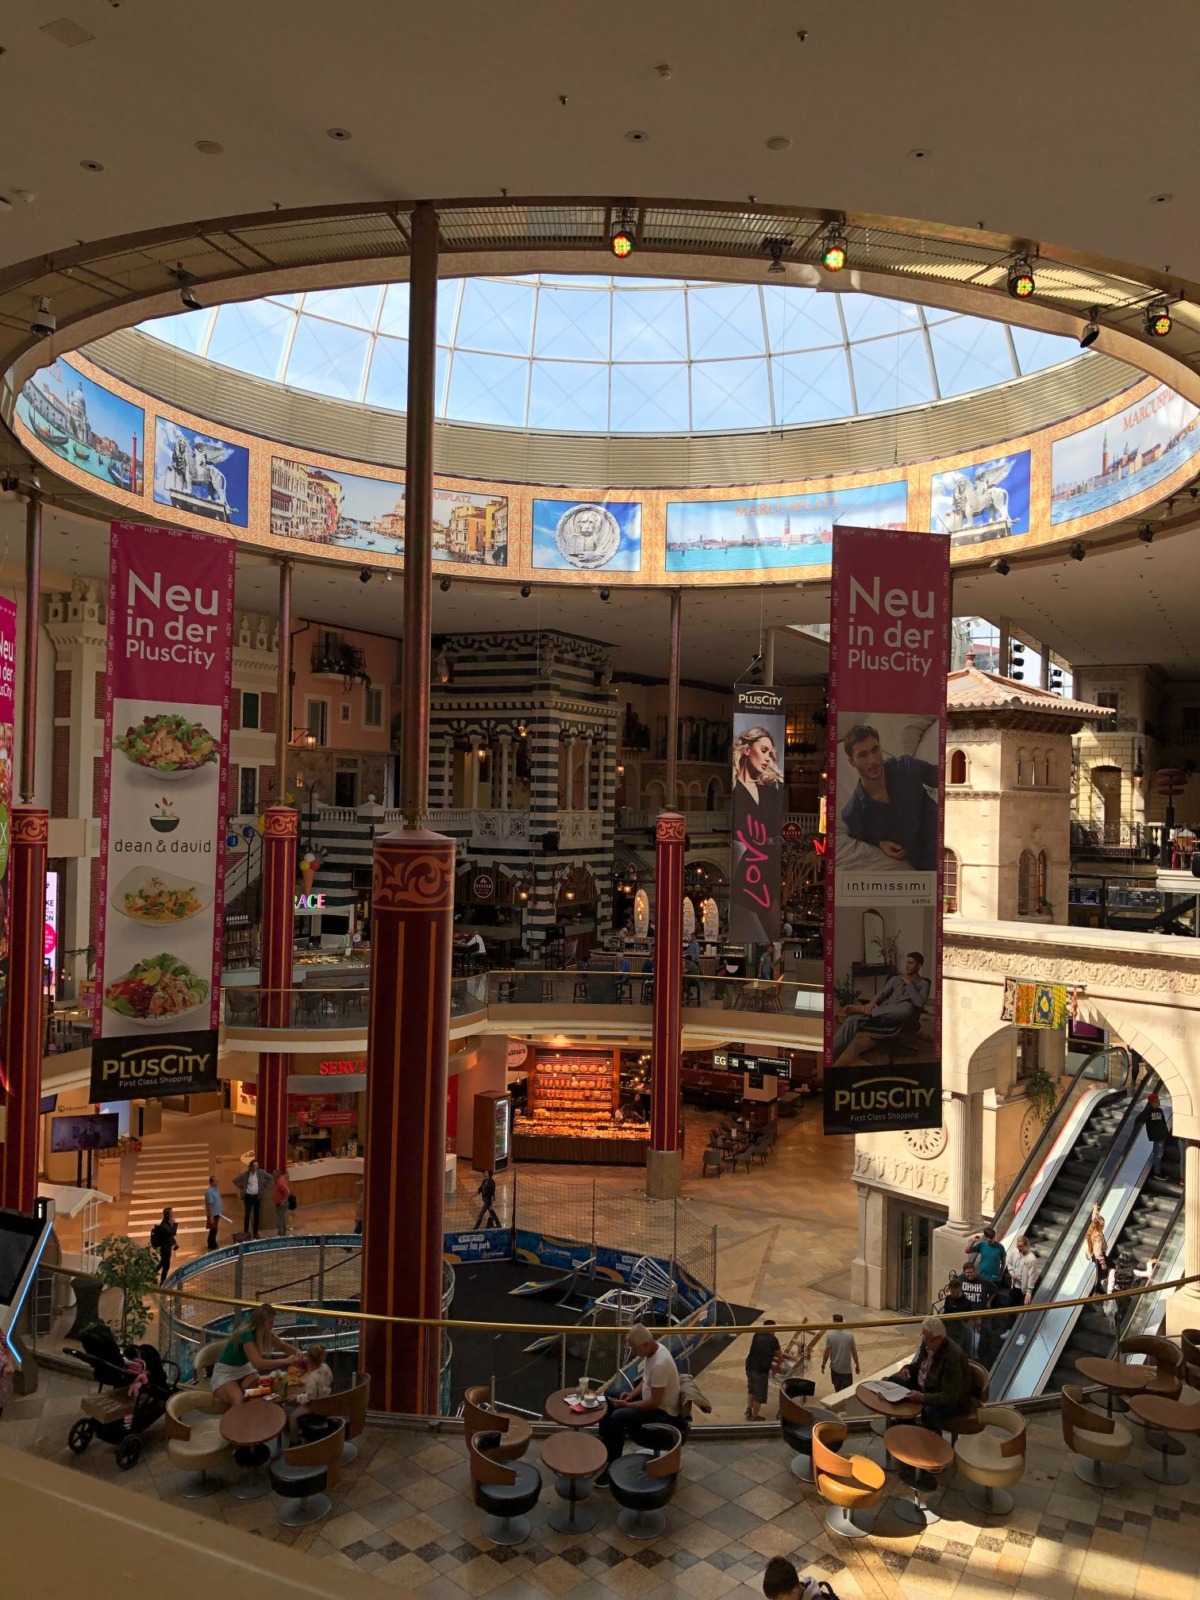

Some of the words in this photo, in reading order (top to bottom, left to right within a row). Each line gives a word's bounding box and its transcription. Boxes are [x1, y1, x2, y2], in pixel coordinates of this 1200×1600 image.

[120, 522, 136, 531] NEW
[128, 568, 218, 616] Neu
[850, 575, 934, 618] Neu
[126, 608, 154, 638] in
[164, 615, 217, 644] der
[849, 618, 874, 646] in
[883, 620, 934, 649] der
[126, 639, 215, 670] PlusCity
[848, 649, 932, 677] PlusCity
[115, 839, 152, 852] dean
[156, 840, 166, 852] &
[171, 840, 211, 853] david
[737, 814, 771, 908] LOVE
[847, 881, 926, 891] intimissimi
[102, 1053, 210, 1081] PLUSCITY
[714, 1056, 726, 1065] EG
[138, 1078, 158, 1086] Class
[159, 1075, 192, 1085] Shopping
[835, 1087, 935, 1111] PLUSCITY
[867, 1113, 886, 1121] Class
[888, 1111, 919, 1120] Shopping
[962, 1281, 982, 1292] OHHH
